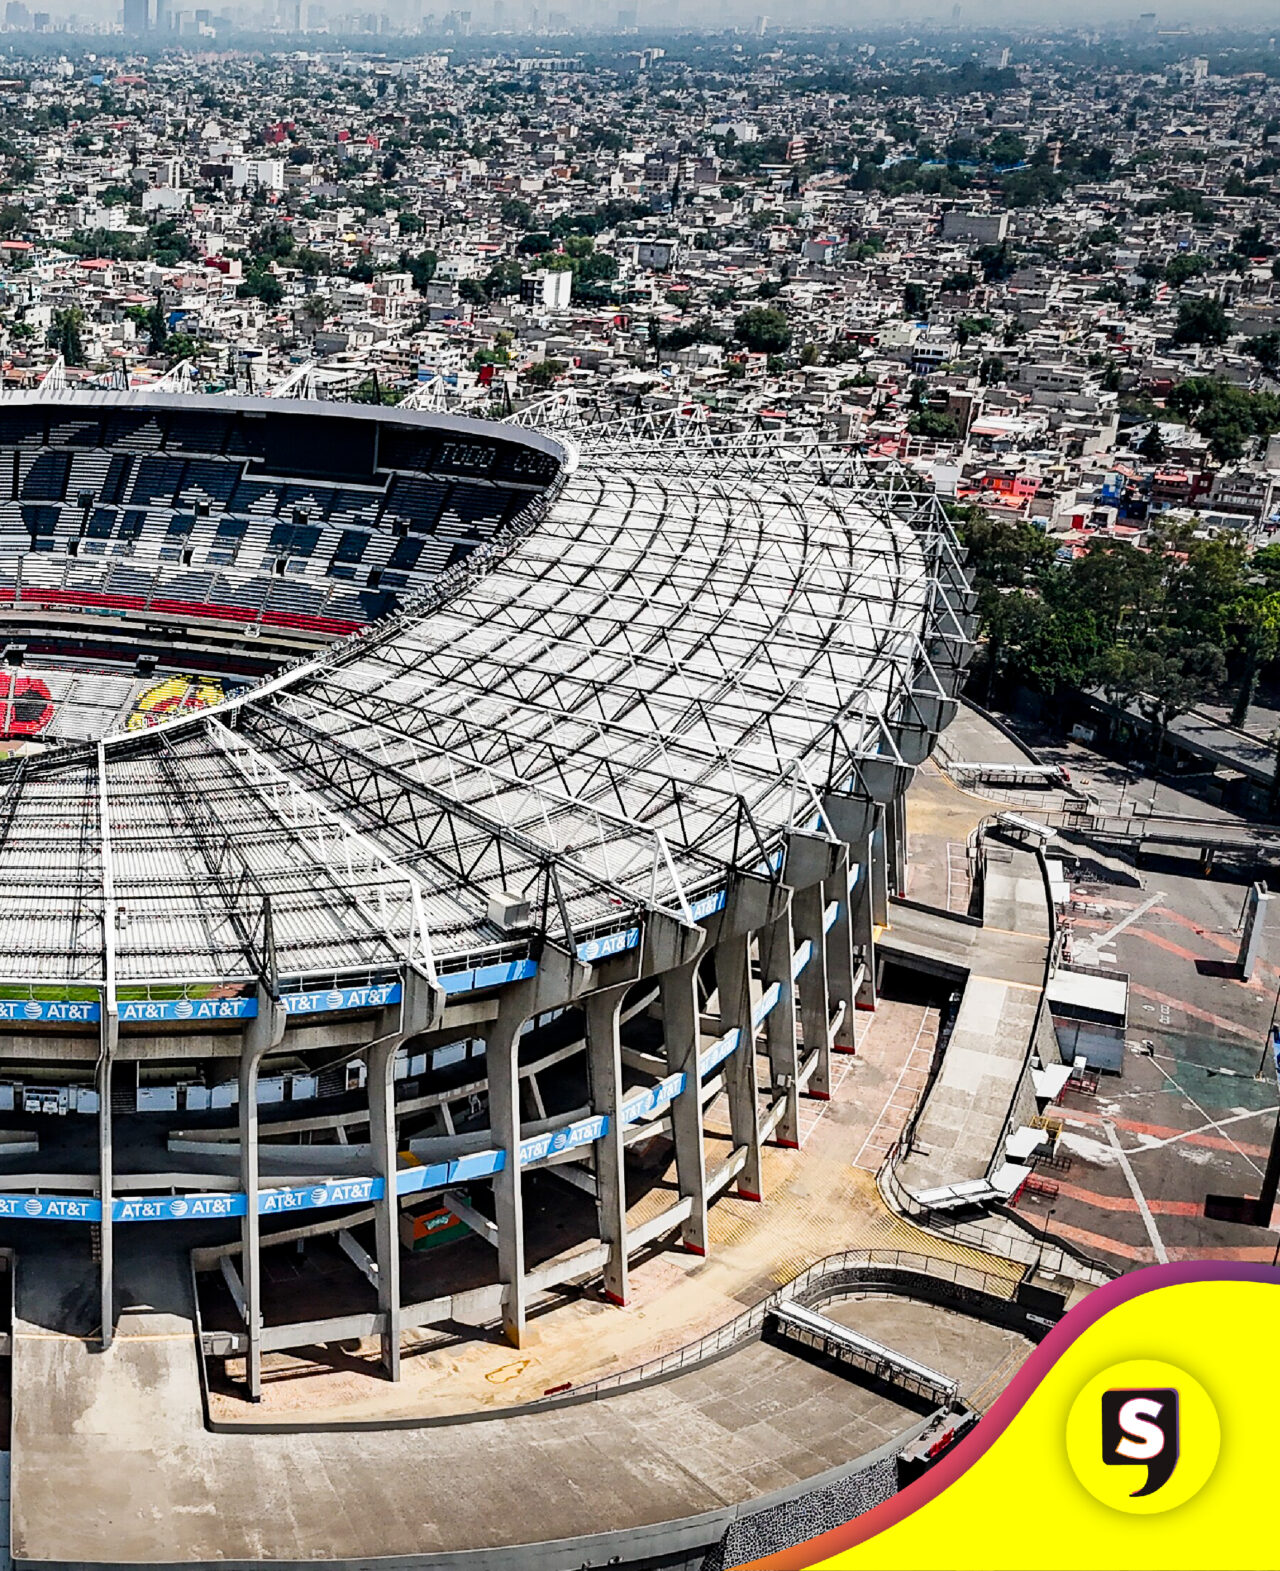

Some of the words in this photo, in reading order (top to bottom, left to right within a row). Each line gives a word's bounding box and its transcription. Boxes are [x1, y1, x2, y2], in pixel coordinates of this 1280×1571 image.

[347, 988, 390, 1005] AT&T
[47, 1003, 91, 1018] AT&T
[124, 1003, 169, 1019] AT&T
[197, 1000, 241, 1017] AT&T
[570, 1123, 602, 1143] AT&T
[264, 1192, 306, 1210] AT&T
[332, 1183, 371, 1201] AT&T
[46, 1202, 89, 1216] AT&T
[122, 1202, 165, 1217] AT&T
[192, 1199, 235, 1214] AT&T
